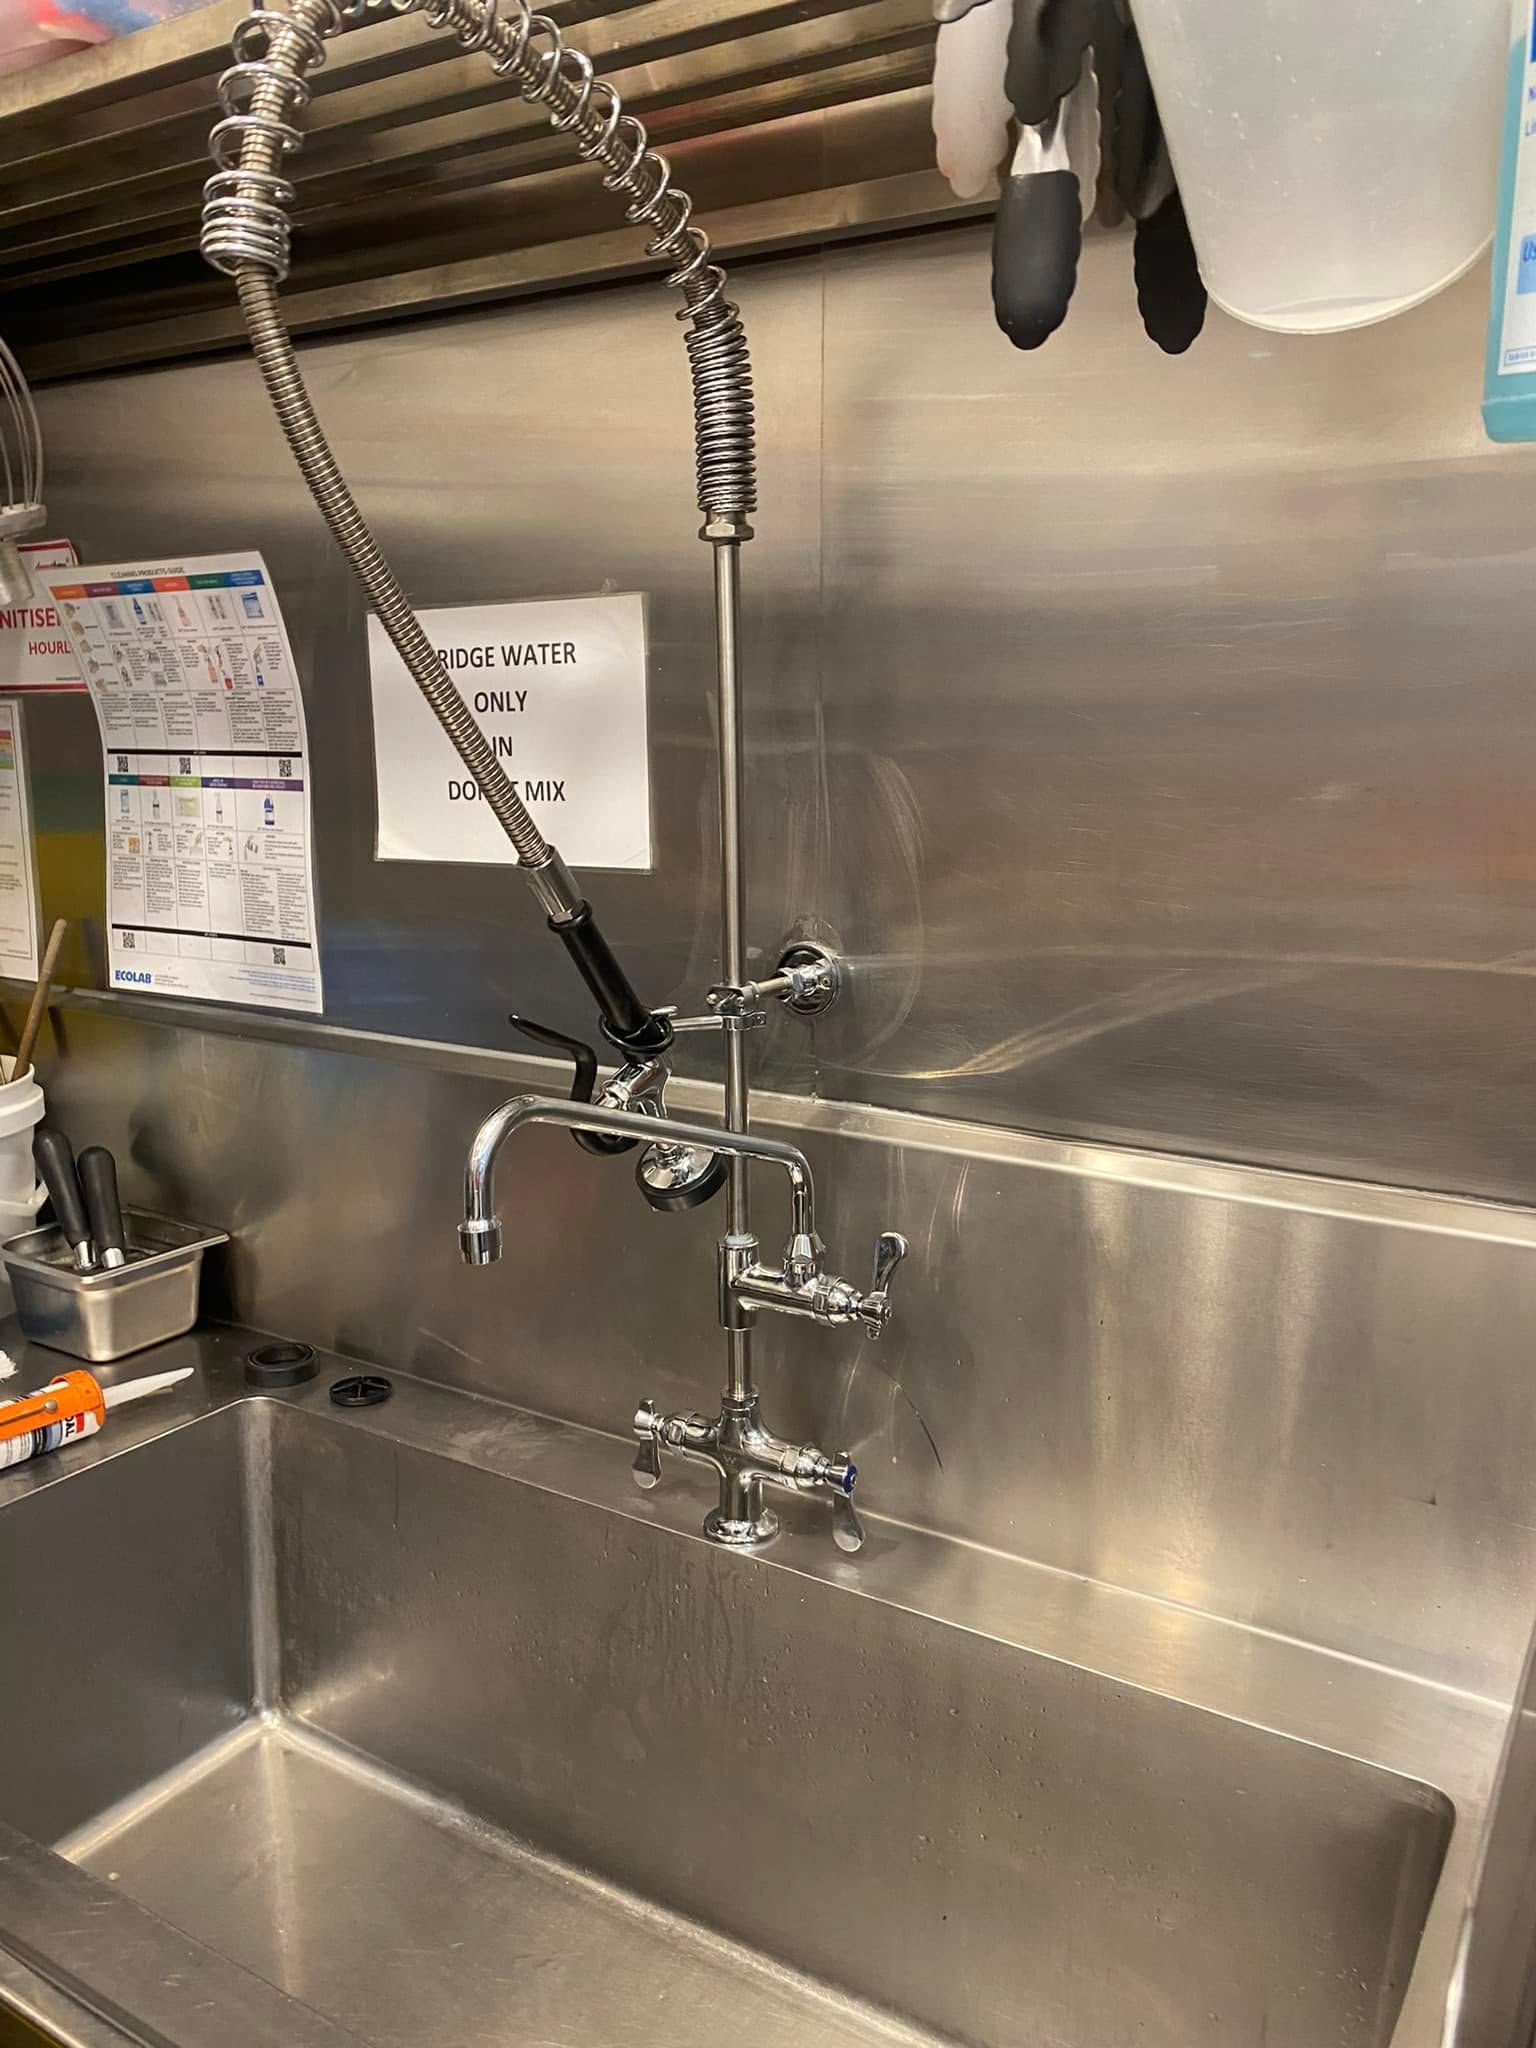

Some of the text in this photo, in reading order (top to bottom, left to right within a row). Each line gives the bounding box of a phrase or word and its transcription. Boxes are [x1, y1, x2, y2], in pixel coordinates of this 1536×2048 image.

[28, 640, 71, 655] HOURL
[437, 642, 577, 670] RIDGE WATER
[474, 690, 528, 713] ONLY
[492, 736, 513, 757] IN
[525, 780, 566, 802] MIX
[114, 969, 152, 984] ECOLAB
